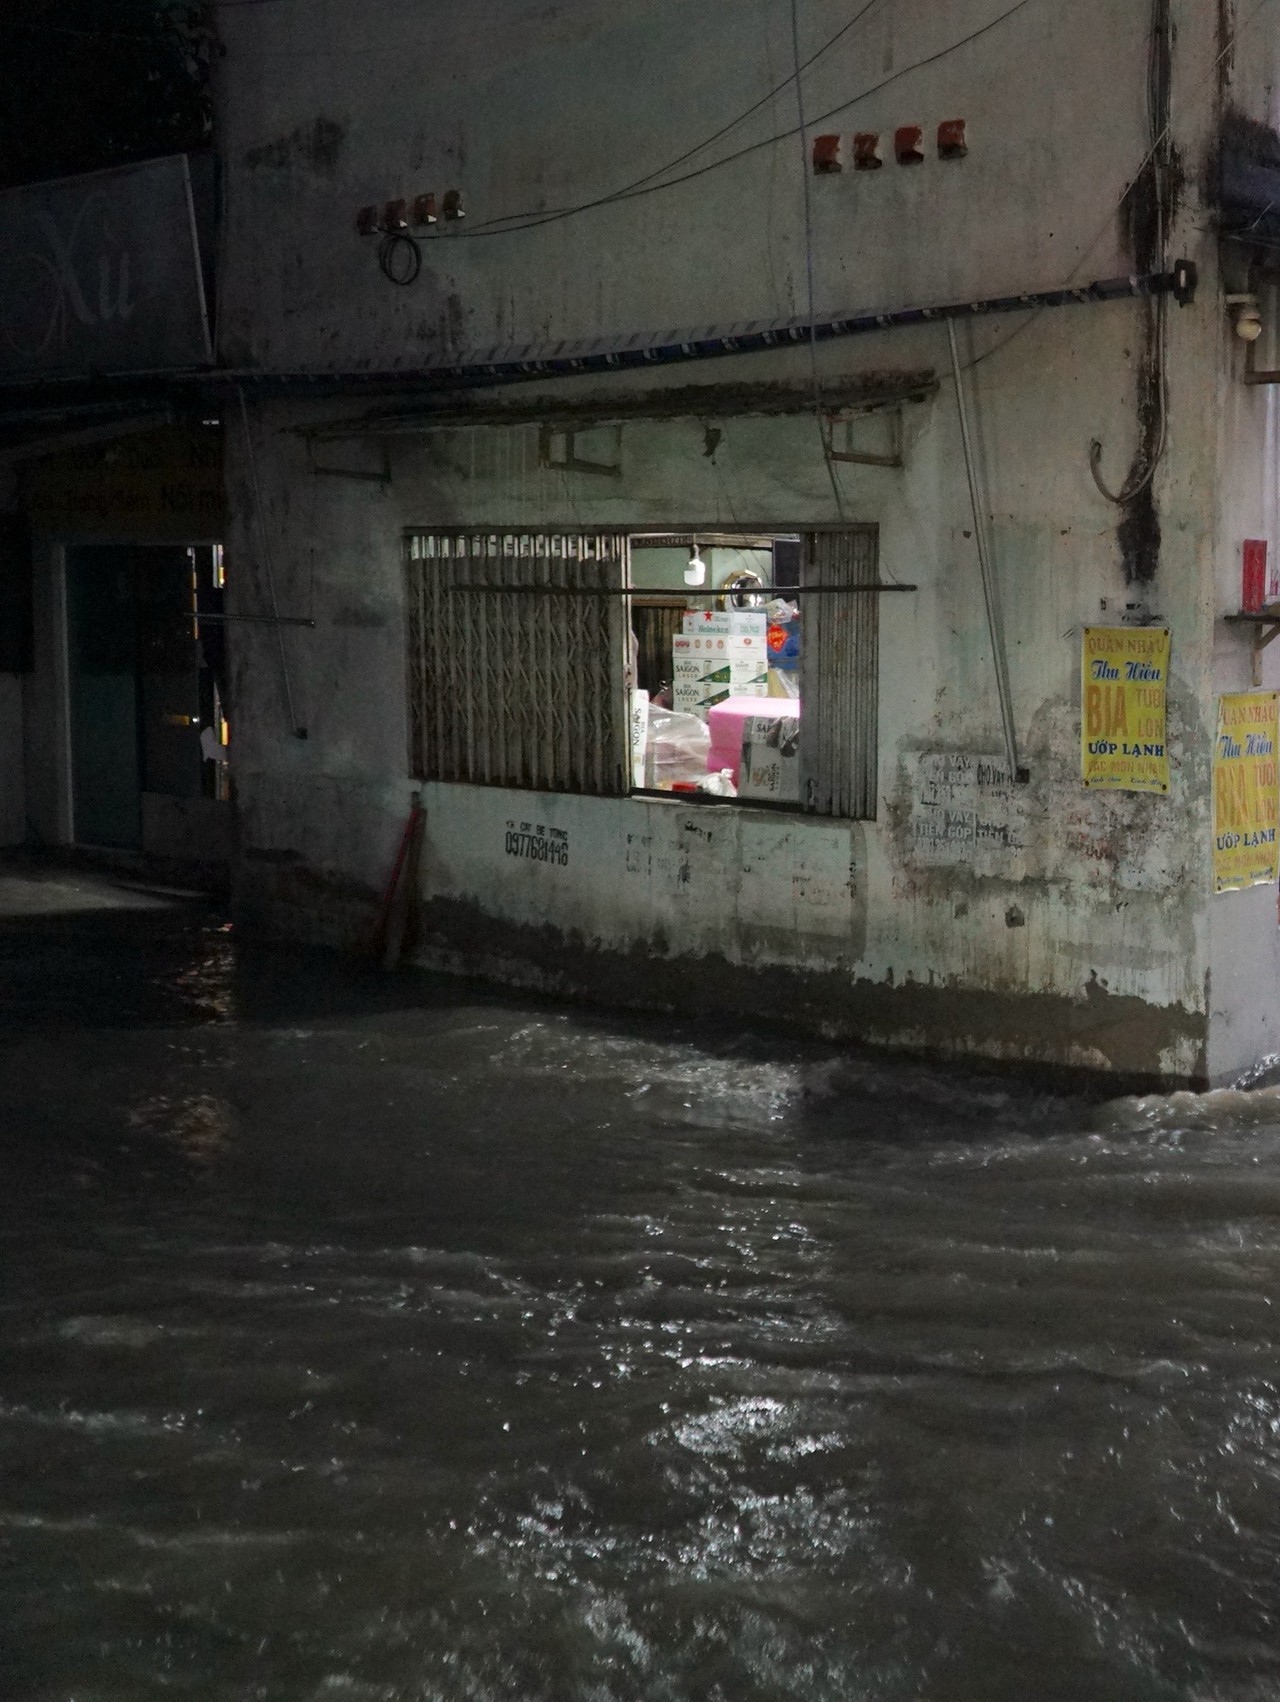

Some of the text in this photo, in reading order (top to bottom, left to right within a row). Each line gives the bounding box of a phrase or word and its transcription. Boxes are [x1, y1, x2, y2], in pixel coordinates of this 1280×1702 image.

[699, 624, 729, 634] Heineken
[676, 665, 700, 673] SAIGON
[1091, 659, 1160, 680] Thu Hiền
[675, 688, 699, 697] SAIGON
[1086, 685, 1128, 738] BIA
[1088, 741, 1164, 759] ƯỚP LẠNH
[1216, 828, 1277, 851] ƯỚP LẠNH
